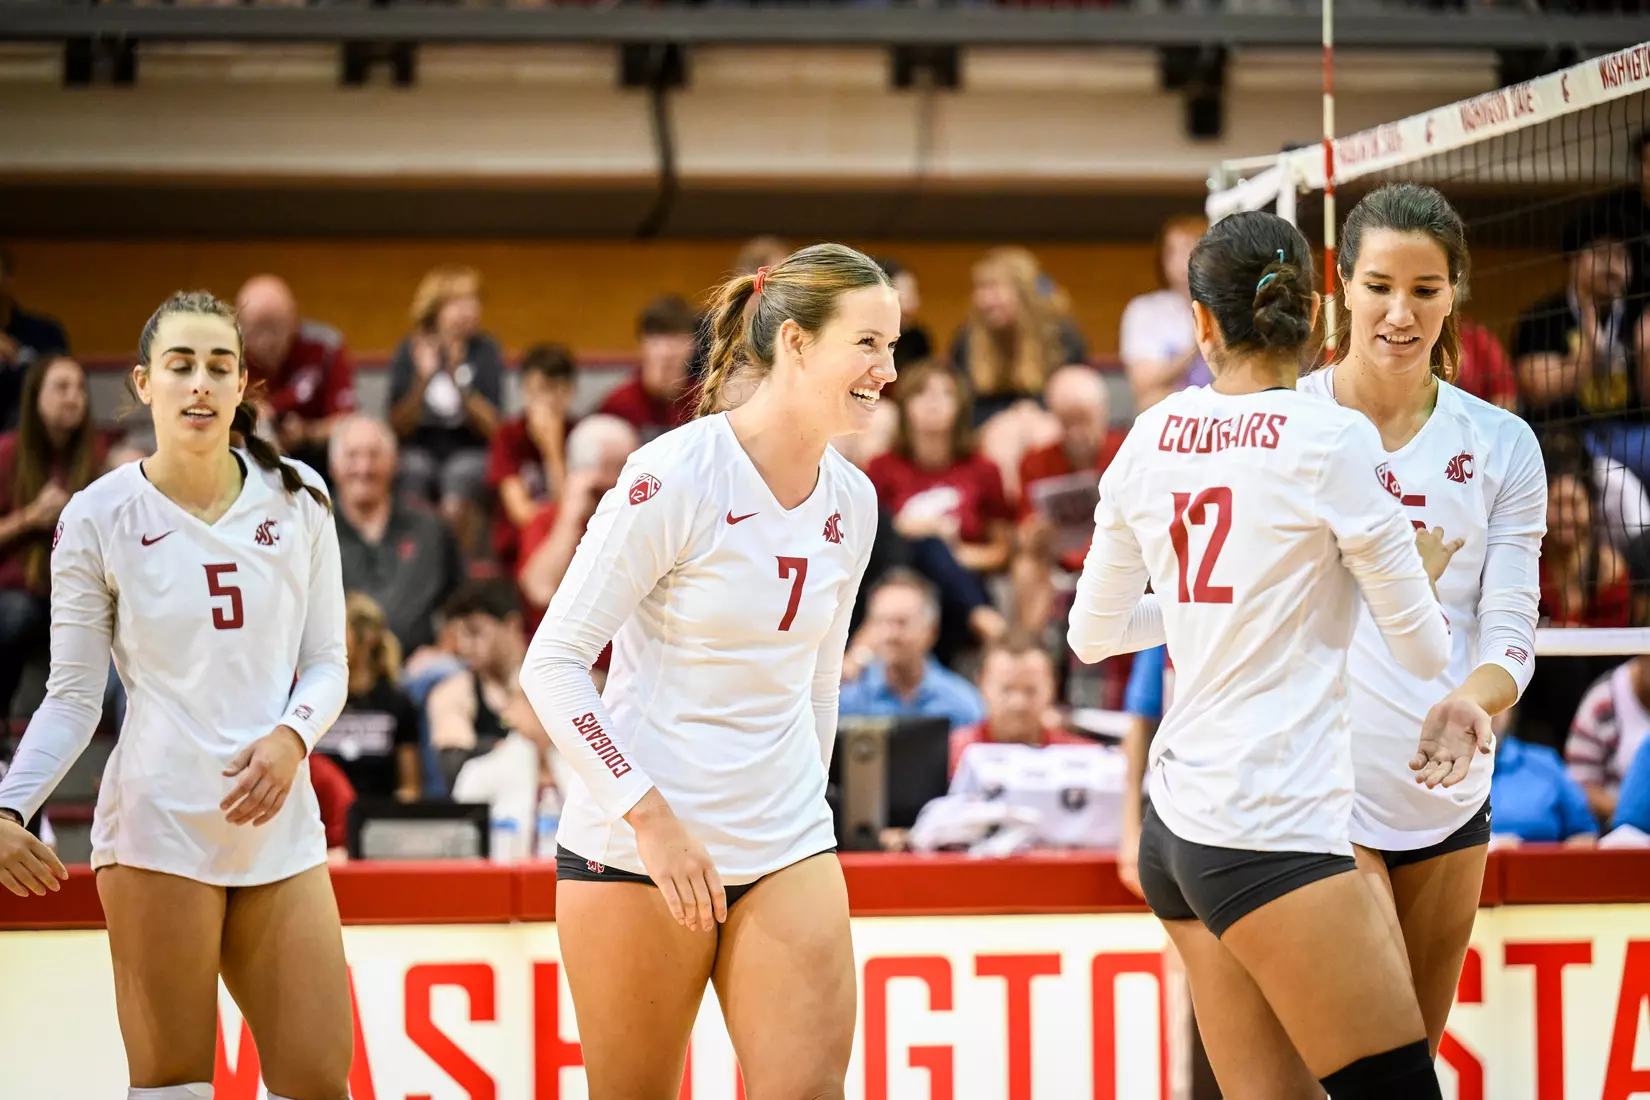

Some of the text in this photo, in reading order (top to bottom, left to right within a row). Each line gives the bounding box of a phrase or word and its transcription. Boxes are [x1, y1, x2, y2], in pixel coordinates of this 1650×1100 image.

[1158, 413, 1288, 454] COUGARS
[631, 489, 646, 502] 12
[1169, 487, 1233, 604] 12
[202, 563, 244, 630] 5
[775, 556, 808, 631] 7
[572, 712, 632, 779] COUGARS
